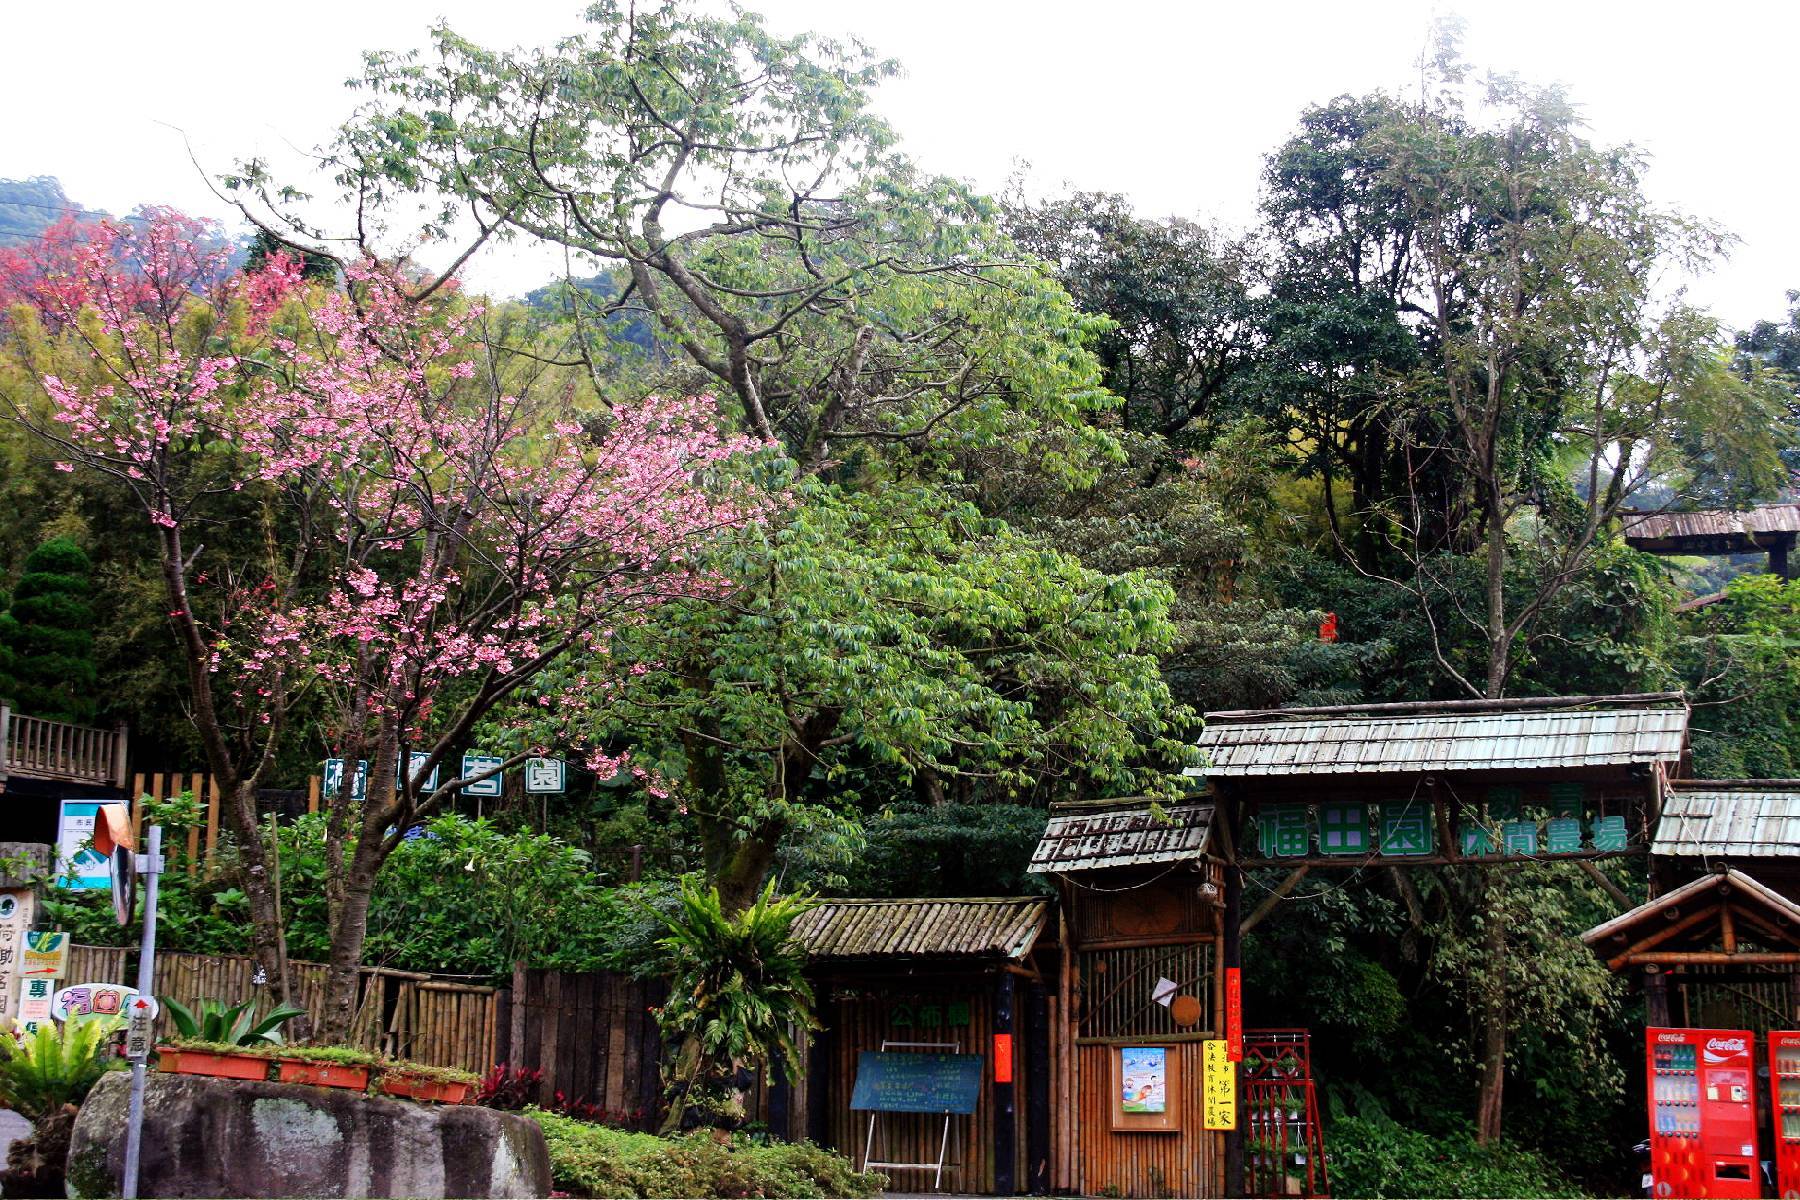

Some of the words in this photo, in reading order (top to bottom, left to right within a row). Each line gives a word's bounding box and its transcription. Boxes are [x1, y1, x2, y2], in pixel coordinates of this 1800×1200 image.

[1258, 802, 1433, 858] 福田園
[130, 1015, 147, 1052] 注意
